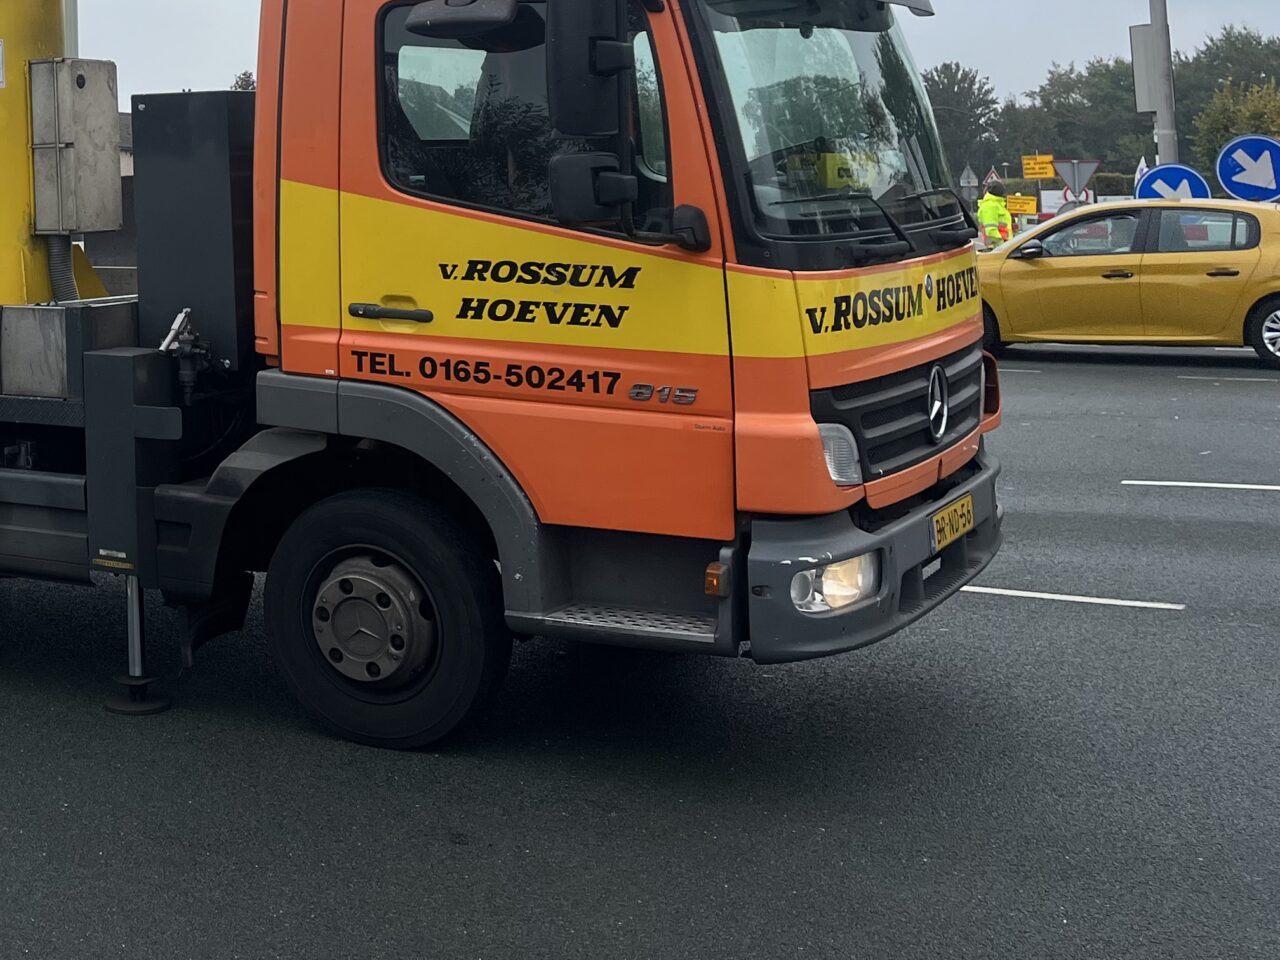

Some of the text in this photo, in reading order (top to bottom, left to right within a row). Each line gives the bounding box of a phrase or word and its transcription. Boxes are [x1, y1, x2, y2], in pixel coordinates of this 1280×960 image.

[936, 266, 978, 312] HOEVE
[455, 297, 630, 328] HOEVEN
[351, 350, 622, 395] TEL. 0165-502417
